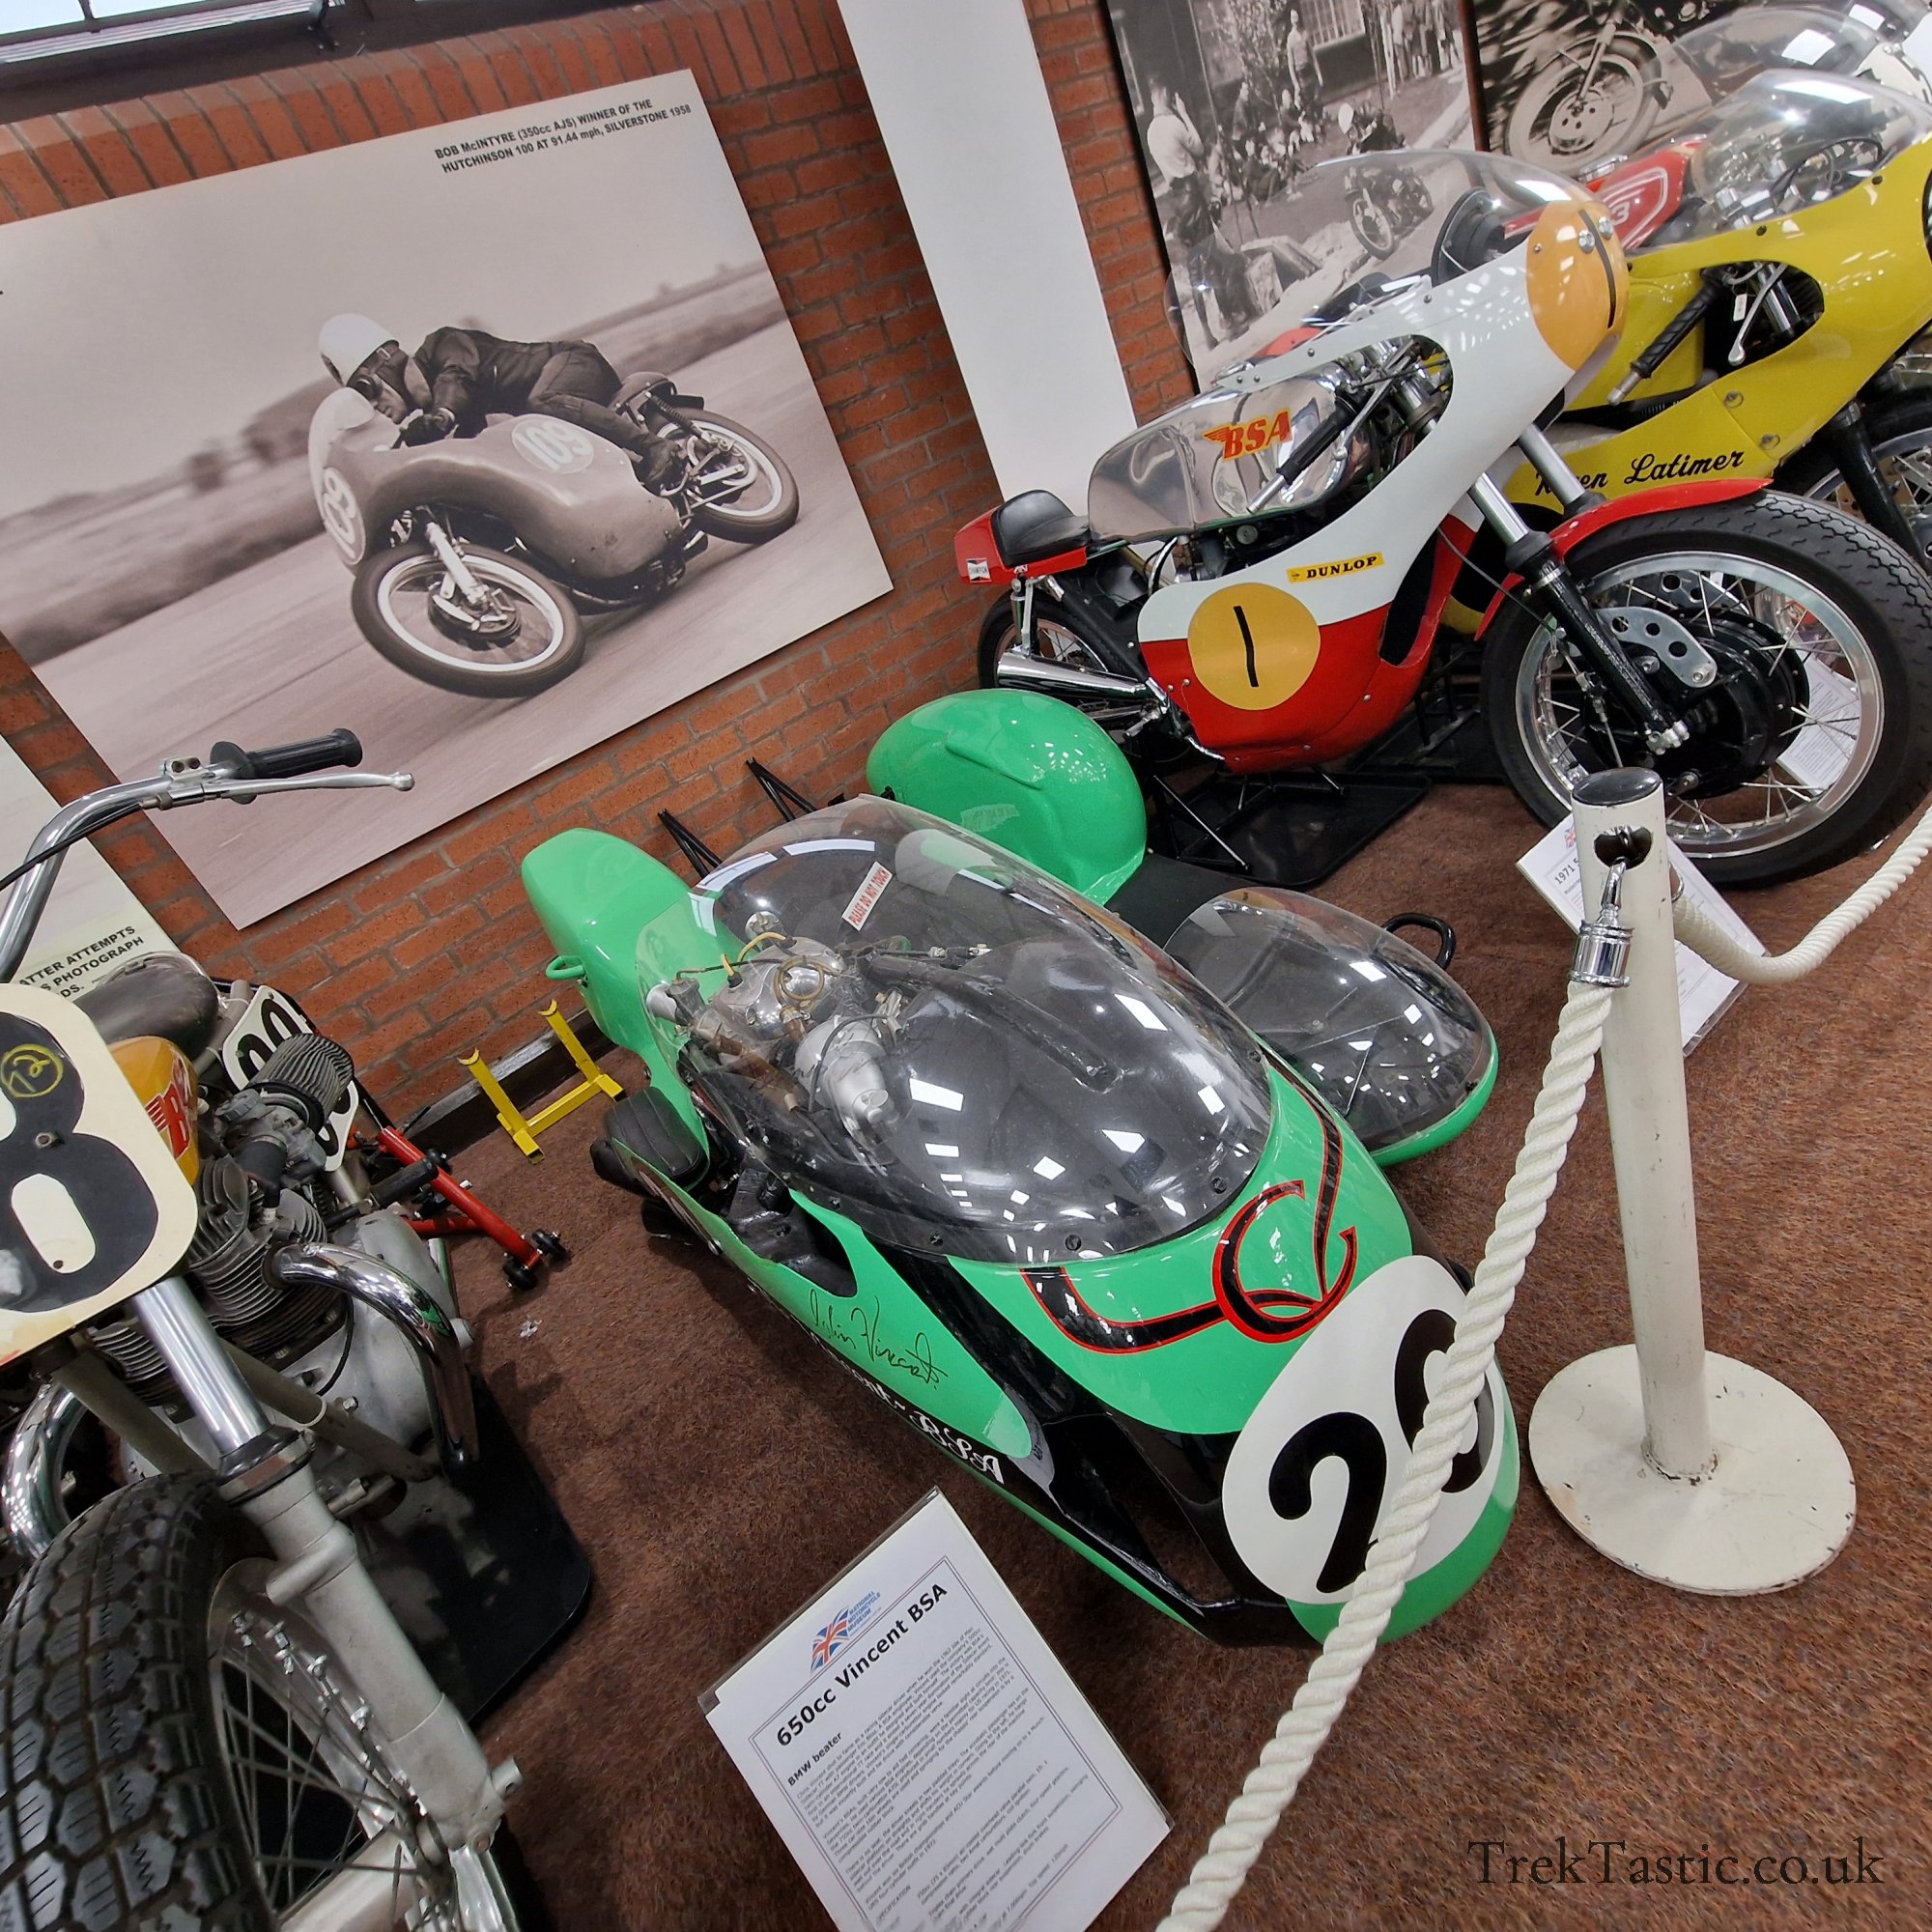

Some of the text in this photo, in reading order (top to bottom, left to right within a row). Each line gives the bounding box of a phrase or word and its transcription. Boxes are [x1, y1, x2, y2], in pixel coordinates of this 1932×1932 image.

[435, 99, 653, 159] BOB McINTYRE (350cc AJS) WINNER OF THE
[441, 103, 692, 173] HUTCHINSON 100 AT 91.44 mph, SILVERSTONE 1958
[516, 421, 591, 470] 109
[1221, 411, 1292, 460] BSA
[1624, 449, 1746, 485] Latimer
[1306, 554, 1378, 579] DUNLOP
[1233, 605, 1260, 689] 1
[1553, 864, 1576, 885] 1971
[52, 936, 144, 986] PHOTOGRAPH
[66, 925, 135, 965] ATTEMPTS
[847, 1607, 871, 1632] MUSEUM
[777, 1688, 837, 1747] 650cc
[835, 1618, 909, 1689] Vincent
[907, 1583, 948, 1623] BSA
[787, 1731, 842, 1786] BMW beater
